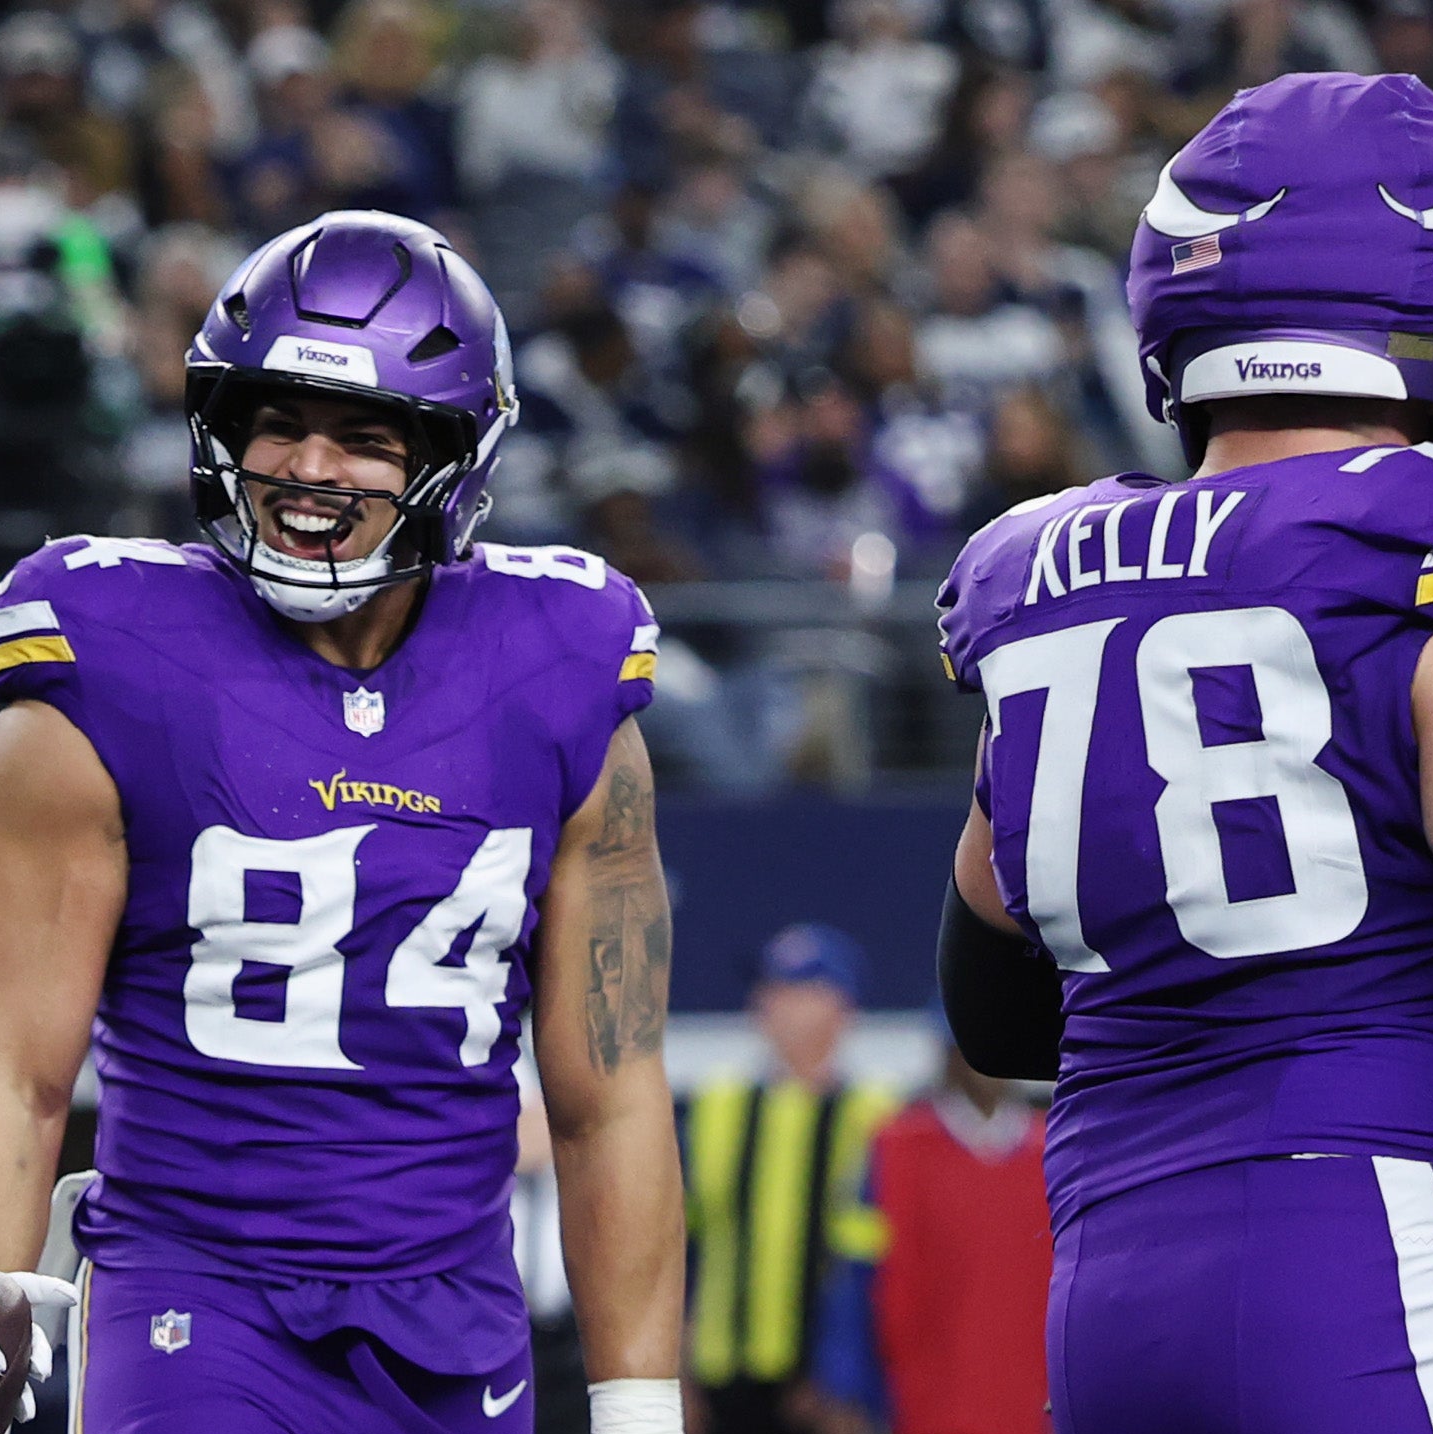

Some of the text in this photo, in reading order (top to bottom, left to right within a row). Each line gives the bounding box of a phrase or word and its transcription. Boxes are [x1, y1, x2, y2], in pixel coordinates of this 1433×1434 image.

[1234, 354, 1322, 382] VIKINGS
[1024, 490, 1246, 606] KELLY
[309, 768, 442, 813] VIKINGS
[977, 606, 1369, 976] 78
[183, 824, 534, 1071] 84
